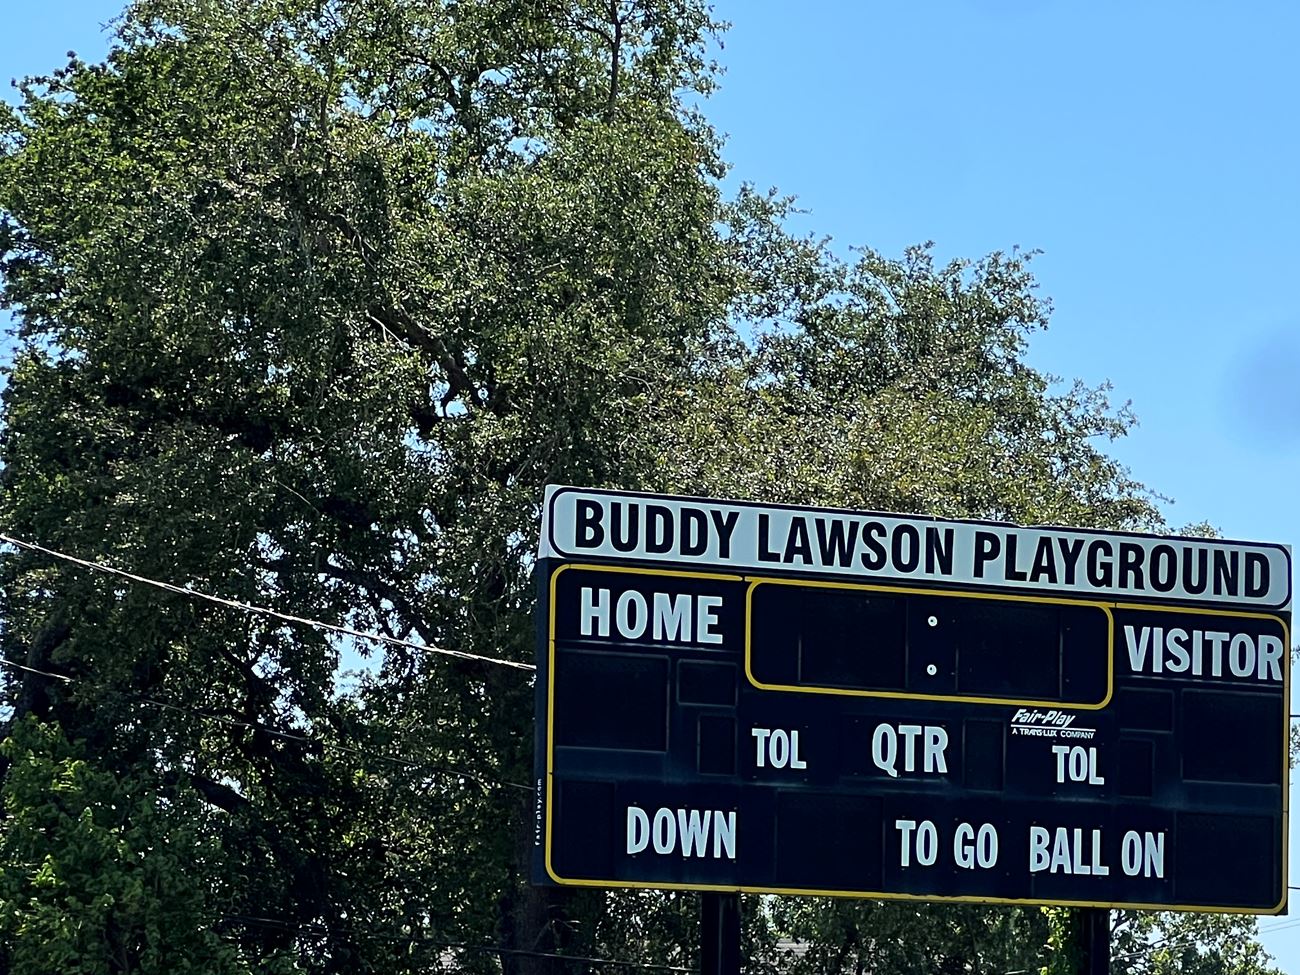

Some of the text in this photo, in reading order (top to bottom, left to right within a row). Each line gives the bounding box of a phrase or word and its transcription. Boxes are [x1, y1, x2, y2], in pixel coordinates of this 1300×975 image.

[575, 498, 1270, 598] BUDDY LAWSON PLAYGROUND
[580, 586, 723, 645] HOME
[1123, 625, 1284, 681] VISITOR
[1011, 708, 1076, 728] Fair-Play
[1011, 727, 1018, 735] A
[1060, 730, 1095, 739] COMPANY
[751, 727, 807, 770] TOL
[871, 722, 949, 778] QTR
[1051, 745, 1105, 785] TOL
[626, 806, 737, 859] DOWN
[895, 819, 999, 870] TO GO
[1029, 826, 1165, 879] BALL ON
